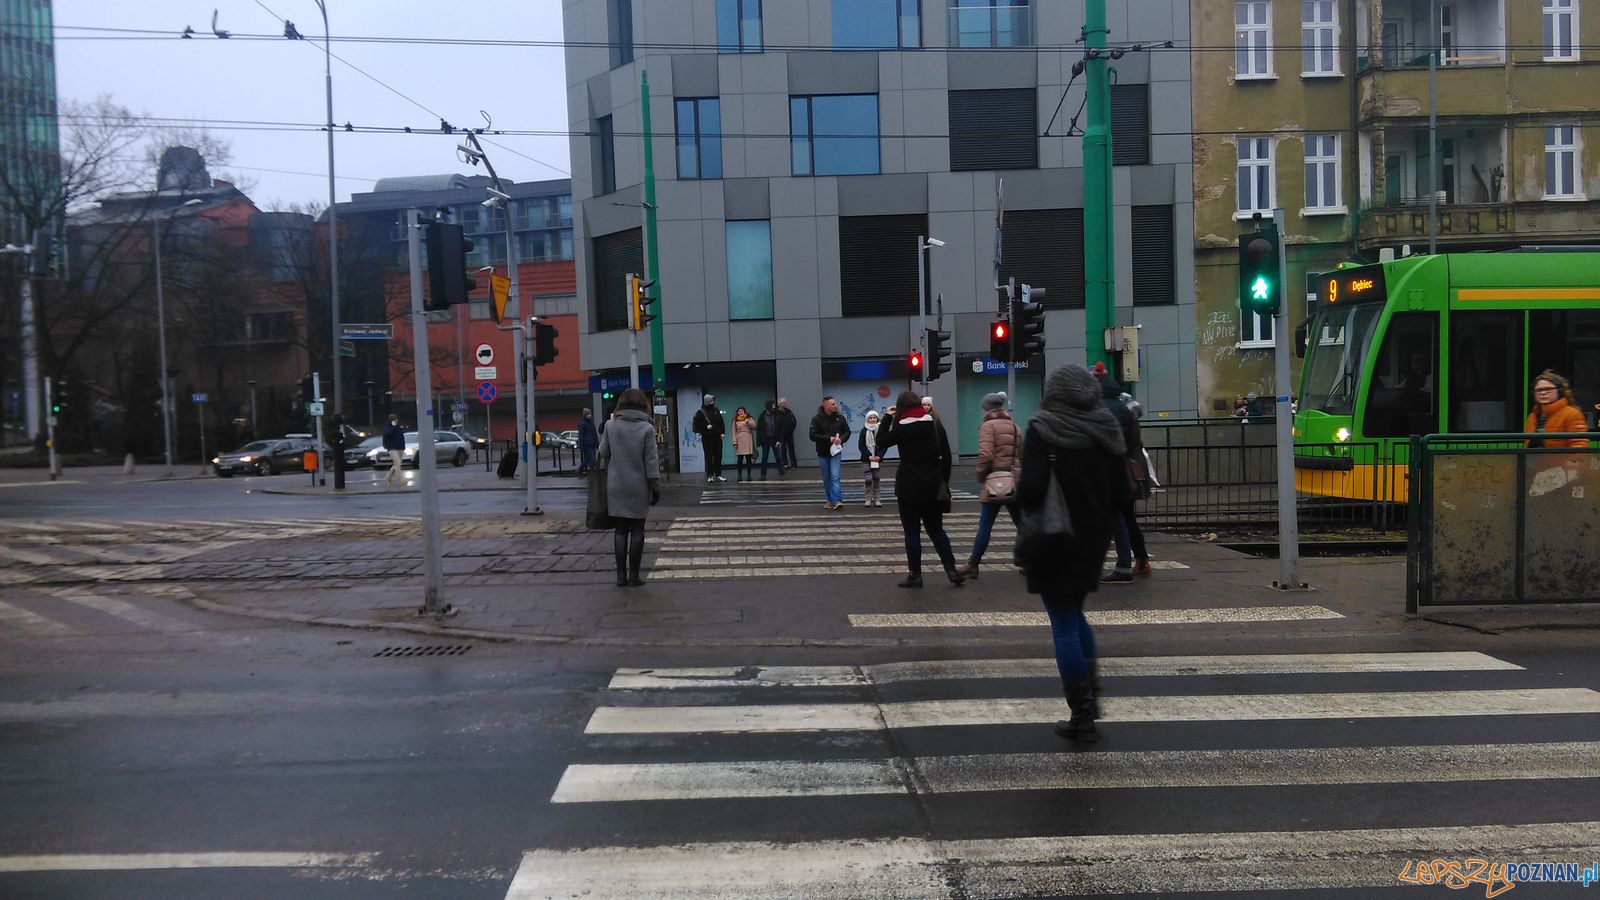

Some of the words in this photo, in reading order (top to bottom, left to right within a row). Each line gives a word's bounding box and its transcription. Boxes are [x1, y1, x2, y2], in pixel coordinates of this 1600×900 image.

[1330, 280, 1337, 302] 9
[1352, 279, 1373, 292] Dębiec
[986, 361, 1006, 370] Bank
